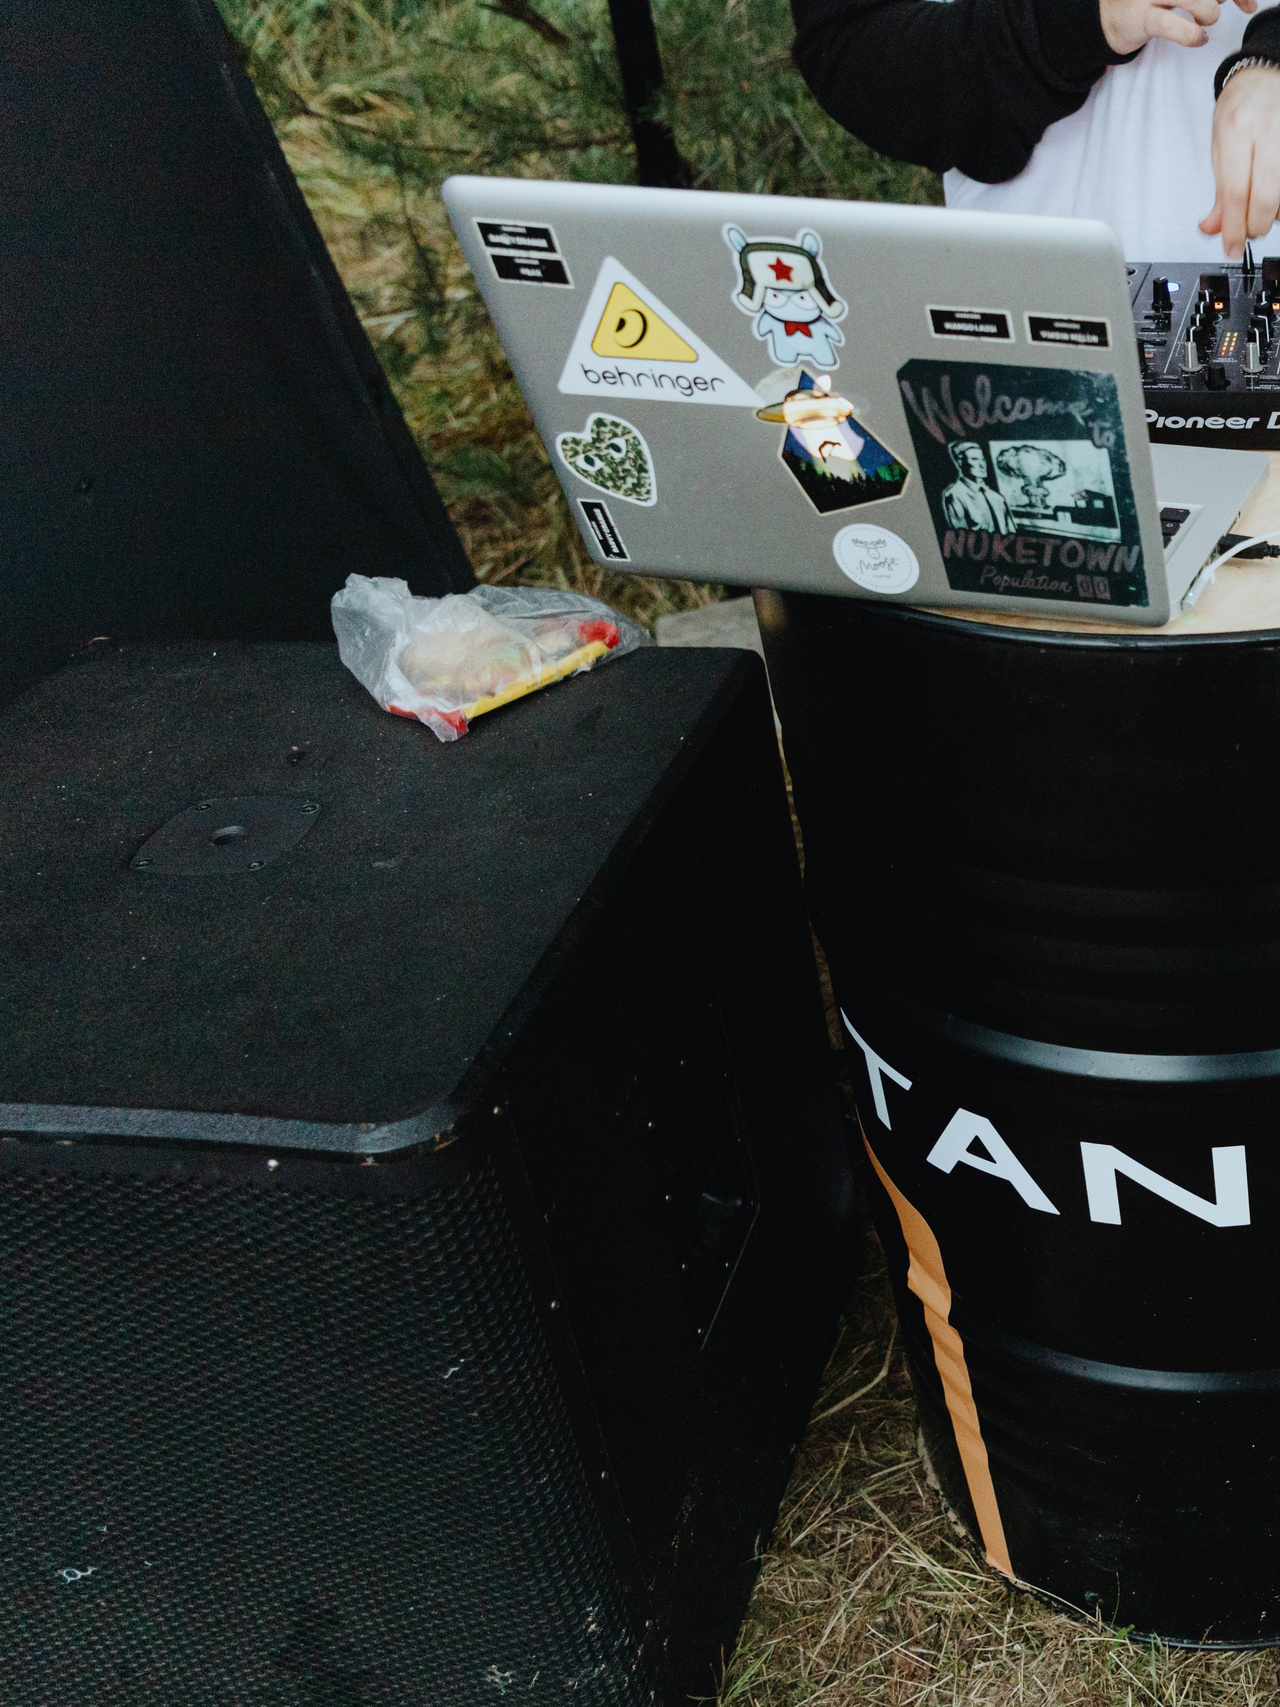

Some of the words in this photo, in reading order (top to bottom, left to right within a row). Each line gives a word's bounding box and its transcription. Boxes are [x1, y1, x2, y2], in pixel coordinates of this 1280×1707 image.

[580, 364, 725, 397] behringer
[900, 374, 1094, 444] Welcome
[1089, 420, 1115, 449] to
[942, 529, 1140, 574] NUKETOWN
[980, 565, 1072, 593] Population
